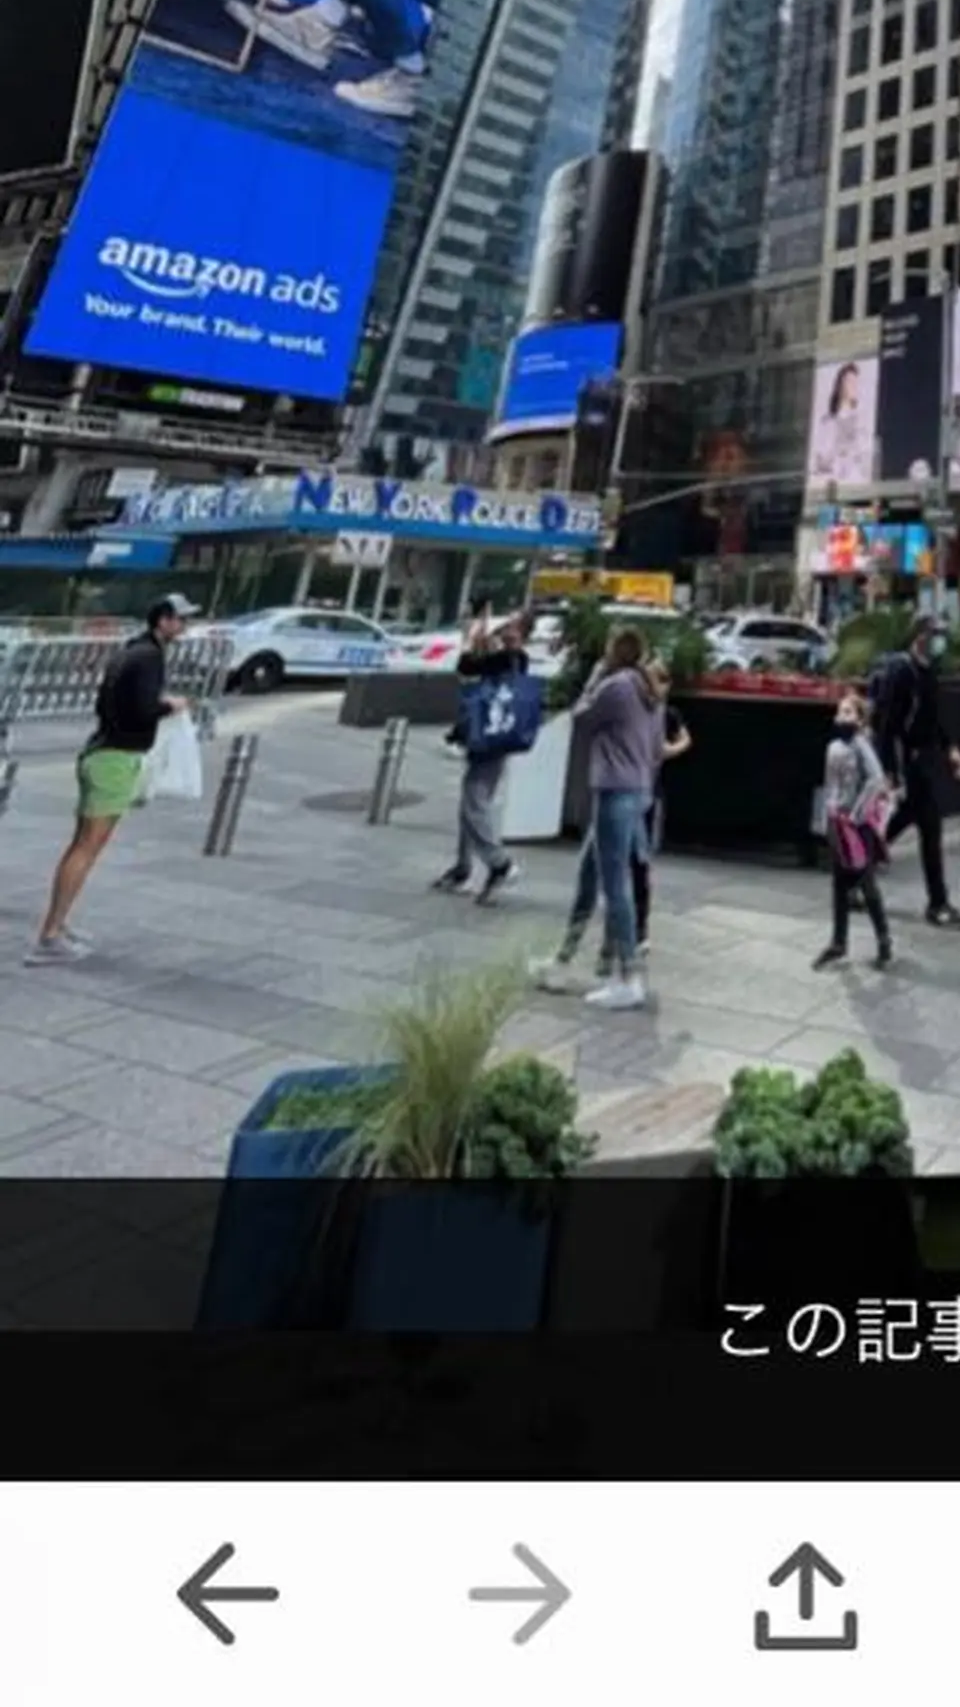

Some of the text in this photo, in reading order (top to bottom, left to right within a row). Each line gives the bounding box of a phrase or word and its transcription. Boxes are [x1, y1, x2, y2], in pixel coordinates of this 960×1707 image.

[98, 234, 341, 315] amazon ads
[83, 291, 135, 320] Your
[139, 302, 208, 335] brand.
[212, 317, 264, 345] Their
